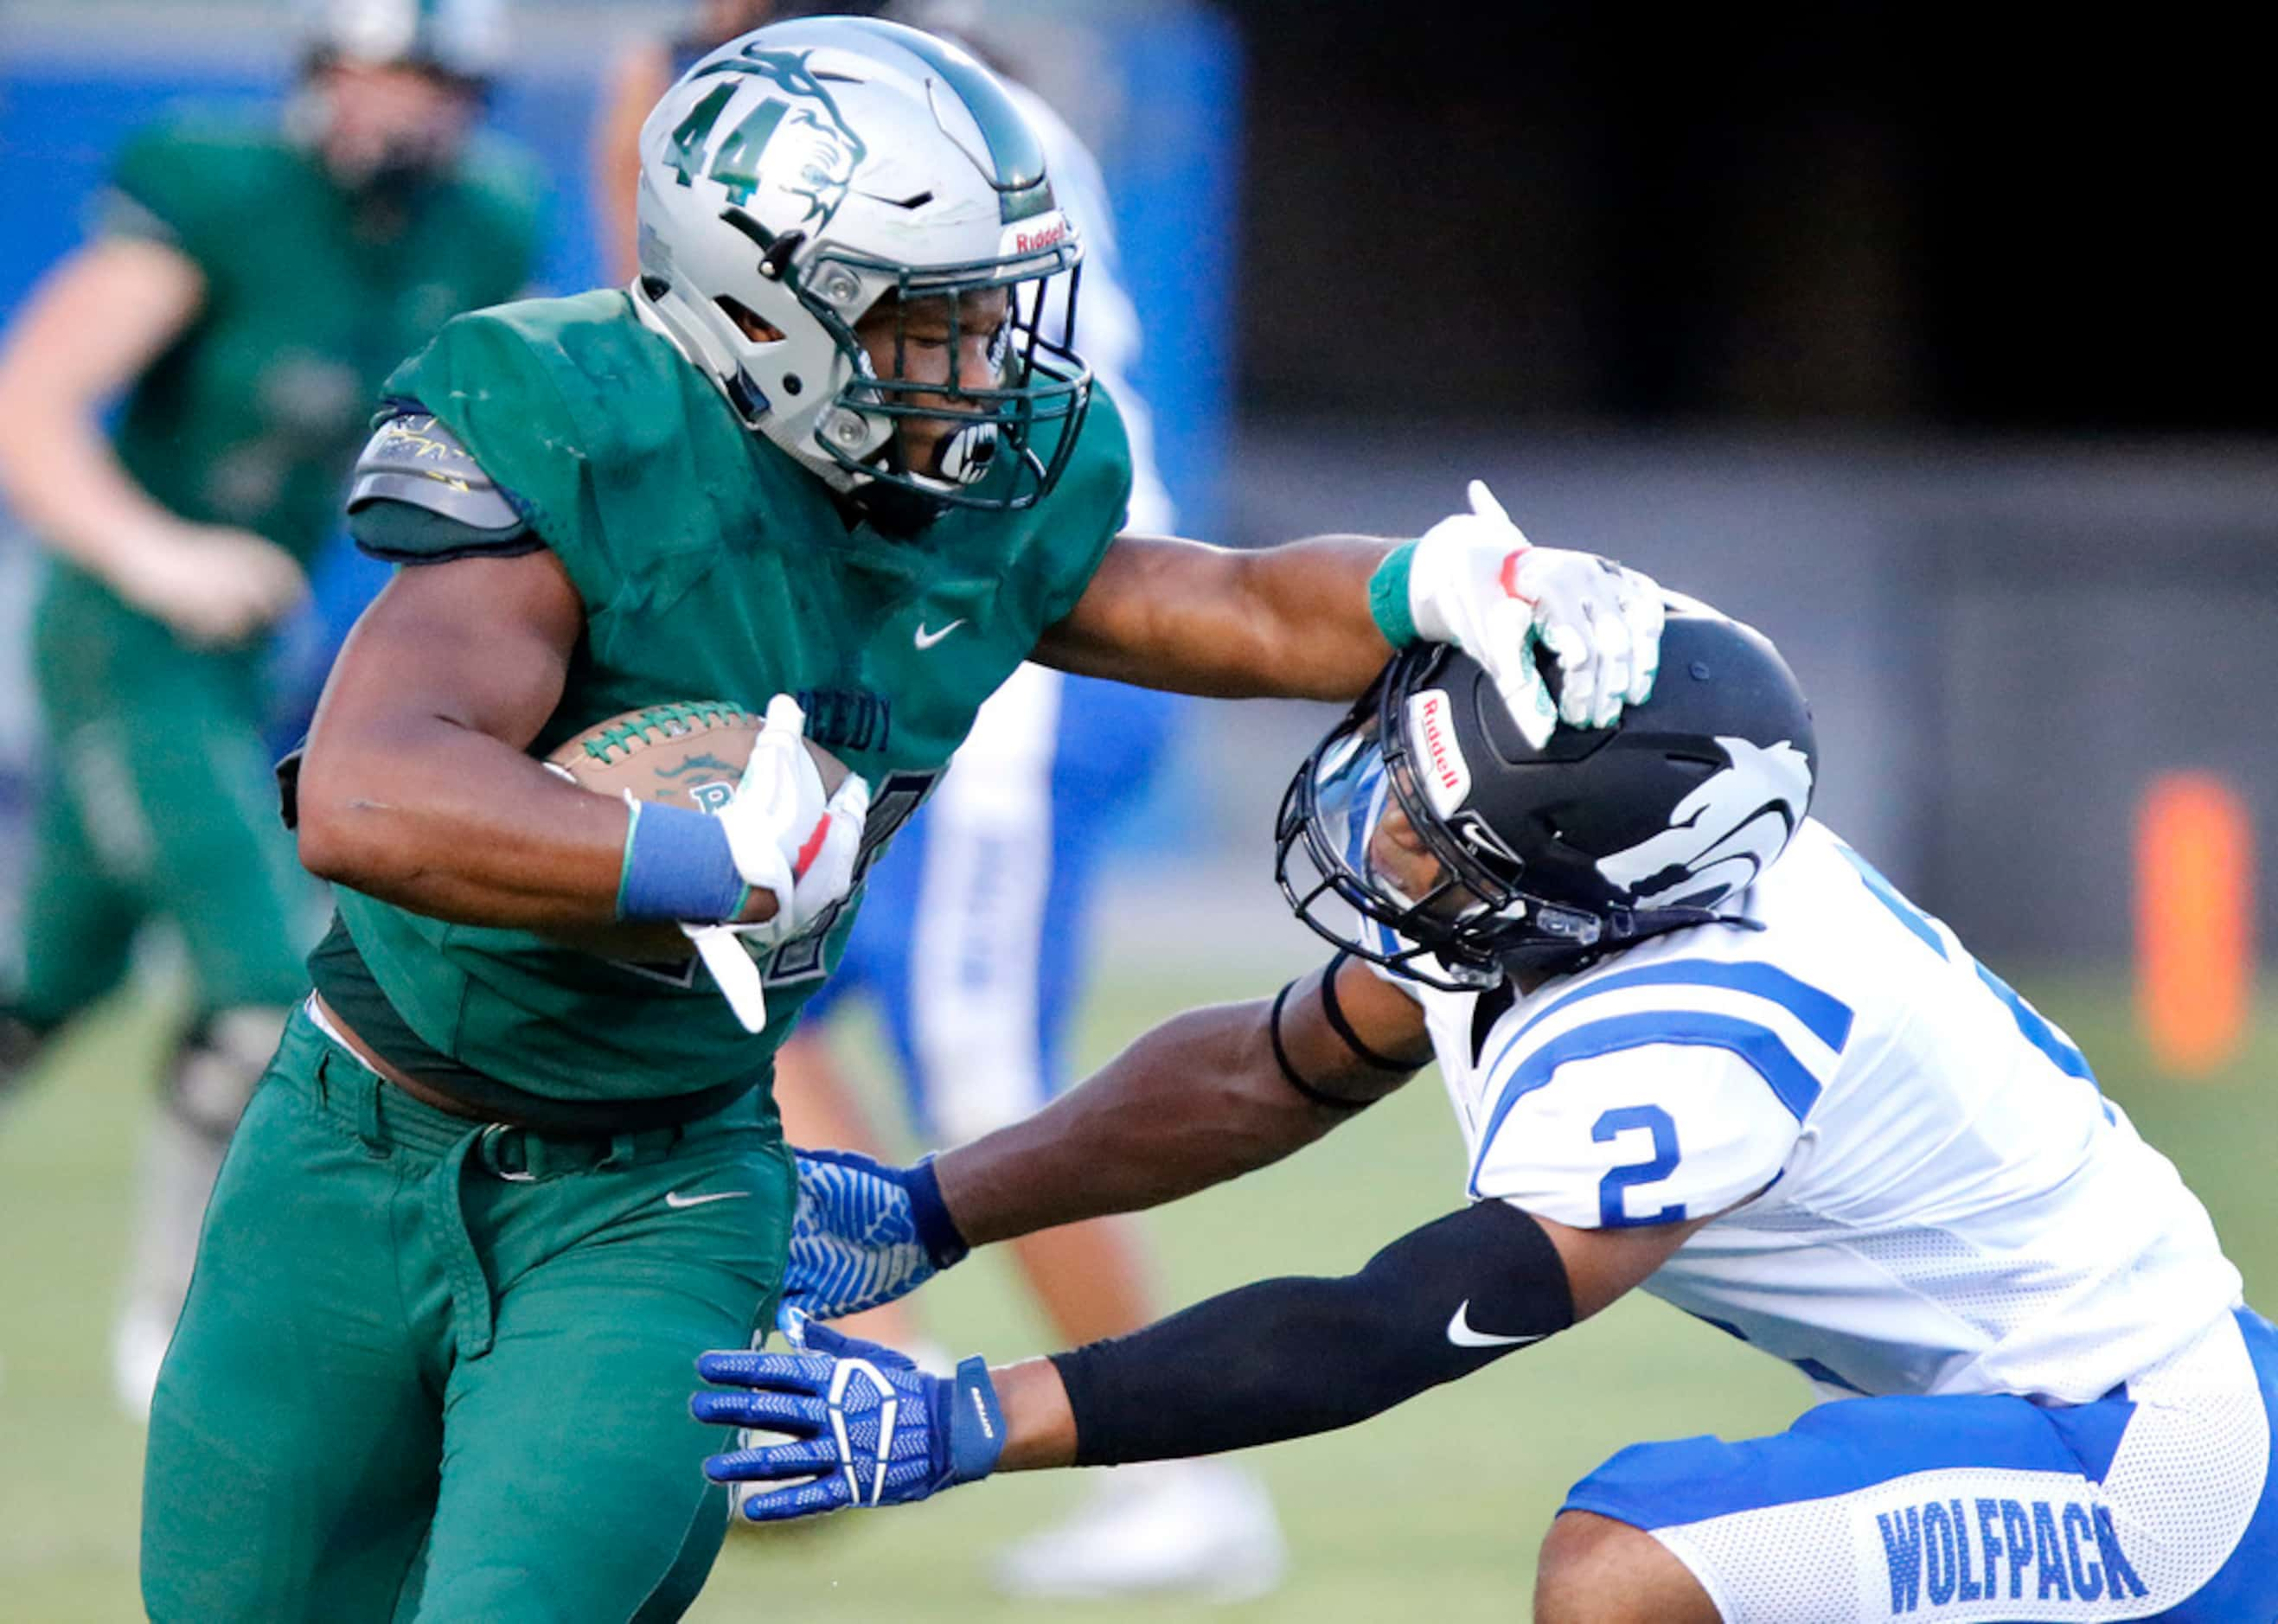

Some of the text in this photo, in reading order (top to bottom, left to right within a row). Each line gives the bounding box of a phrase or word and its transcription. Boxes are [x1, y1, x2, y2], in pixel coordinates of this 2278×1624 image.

[662, 77, 790, 208] 44
[1423, 698, 1460, 790] Riddell
[1591, 1103, 1687, 1227] 2
[1875, 1497, 2151, 1615] WOLFPACK
